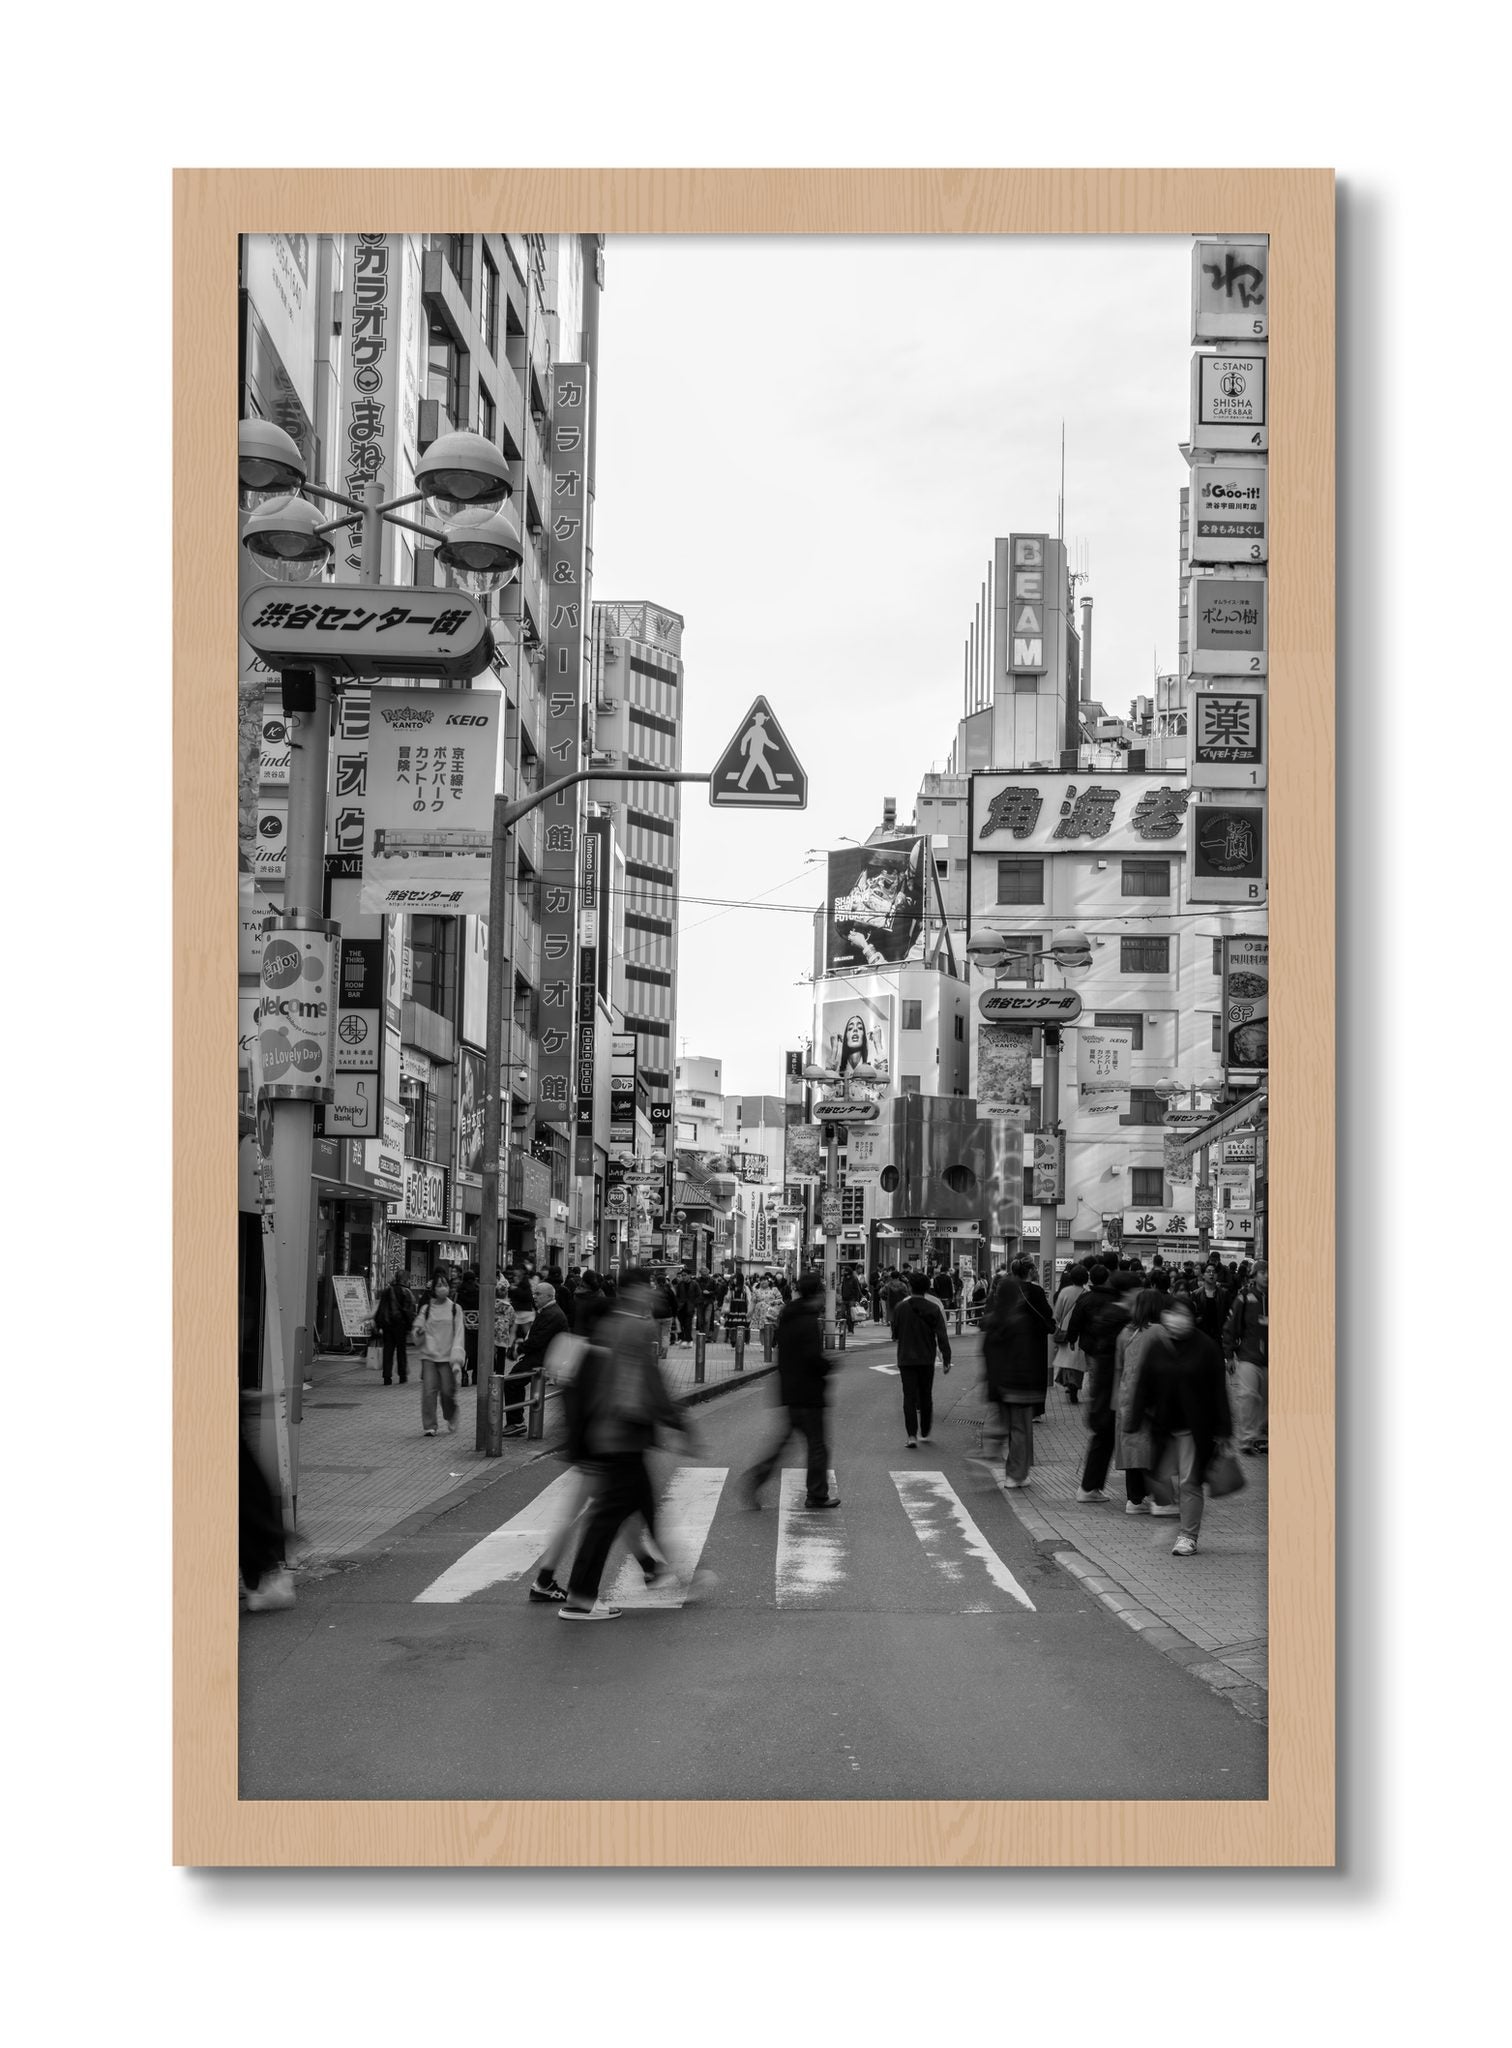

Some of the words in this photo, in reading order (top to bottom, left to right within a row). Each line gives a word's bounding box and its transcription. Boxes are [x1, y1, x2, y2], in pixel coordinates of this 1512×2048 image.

[352, 246, 388, 367] カラオケ
[1253, 321, 1263, 334] 5
[1213, 363, 1253, 371] C.STAND
[1213, 399, 1252, 408] SHISHA
[1212, 485, 1260, 499] Goo-it!
[1201, 524, 1261, 535] 全身もみほぐし
[1250, 544, 1261, 559] 3
[1014, 539, 1043, 666] BEAM
[252, 602, 472, 636] 渋谷センター街
[1250, 657, 1260, 671] 2
[446, 714, 489, 727] KEIO
[1204, 700, 1250, 745] 薬
[1200, 747, 1254, 760] マツモトキヨシ
[397, 746, 411, 784] 冒険へ
[264, 770, 285, 779] 渋谷店
[413, 747, 429, 812] カントーの
[431, 746, 447, 812] ポケパーク
[450, 747, 465, 799] 京王線で
[1249, 771, 1257, 784] 1
[979, 785, 1192, 839] 角海老
[586, 838, 594, 869] kimono
[385, 890, 464, 901] 渋谷センター街
[1248, 884, 1259, 898] B
[263, 951, 299, 982] Enjoy
[540, 887, 571, 1102] カラオケ館
[260, 996, 327, 1018] Welcome
[985, 997, 1076, 1009] 渋谷センター街
[1228, 1005, 1254, 1022] 6F
[275, 1047, 302, 1065] Lovely
[303, 1048, 320, 1060] Day!
[334, 1105, 364, 1116] Whisky
[653, 1108, 670, 1119] GU
[334, 1114, 351, 1122] Bank
